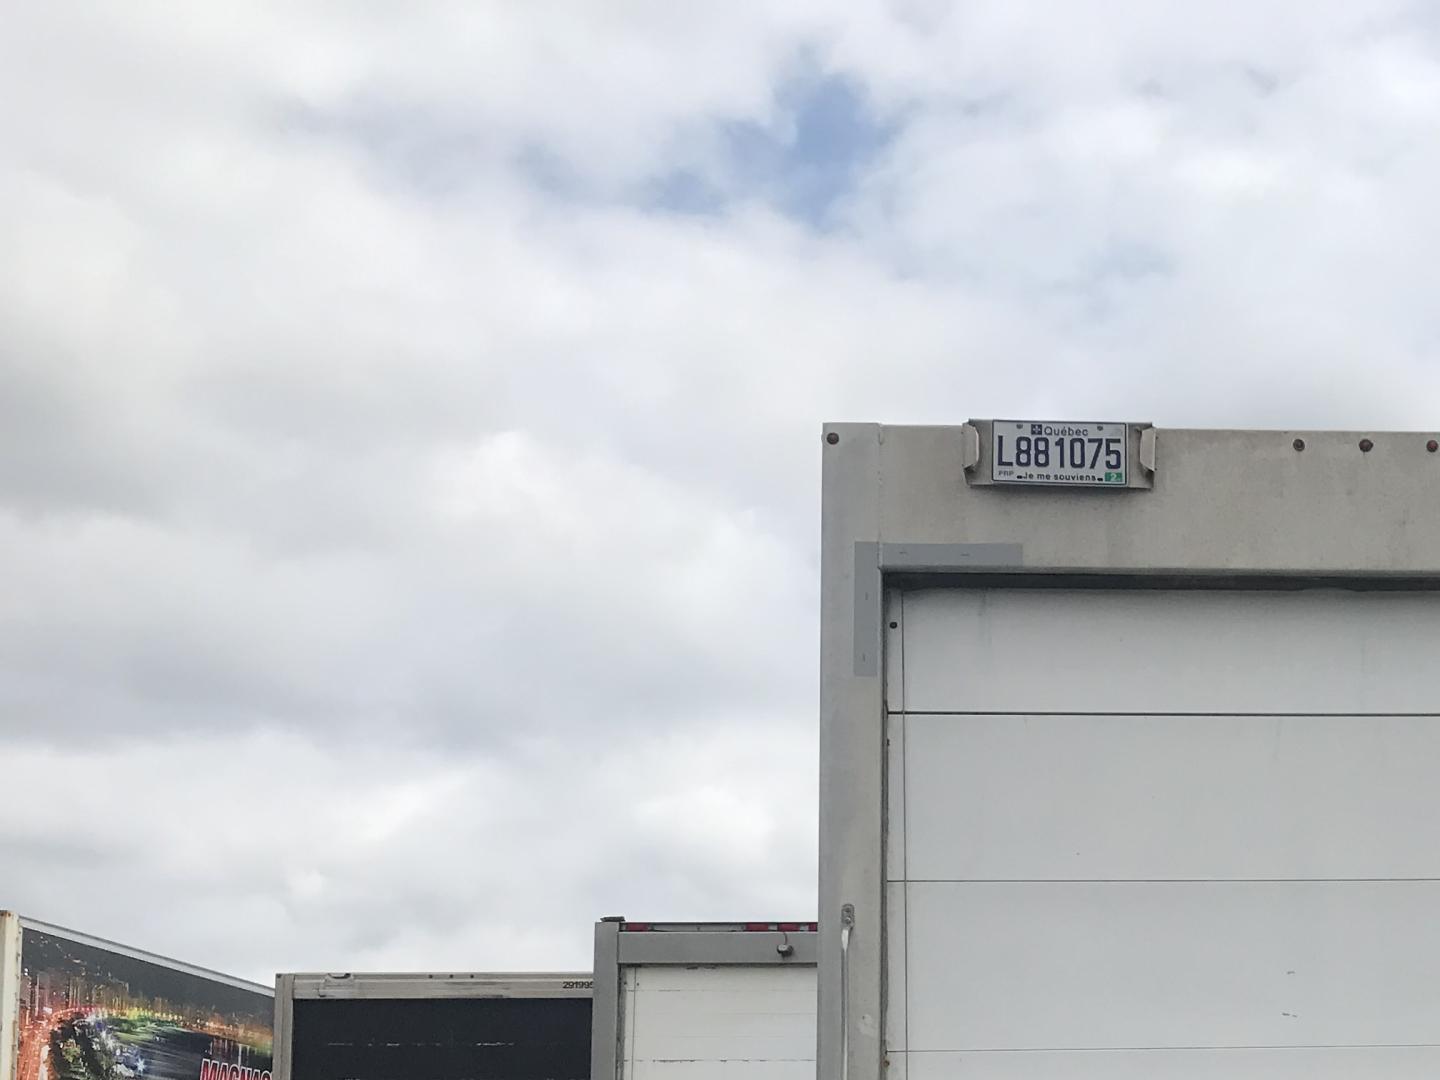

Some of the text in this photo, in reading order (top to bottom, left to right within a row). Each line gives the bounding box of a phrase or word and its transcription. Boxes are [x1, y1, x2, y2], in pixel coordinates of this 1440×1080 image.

[1043, 426, 1089, 437] Québec
[997, 435, 1121, 469] L881075
[1054, 473, 1096, 482] souviens
